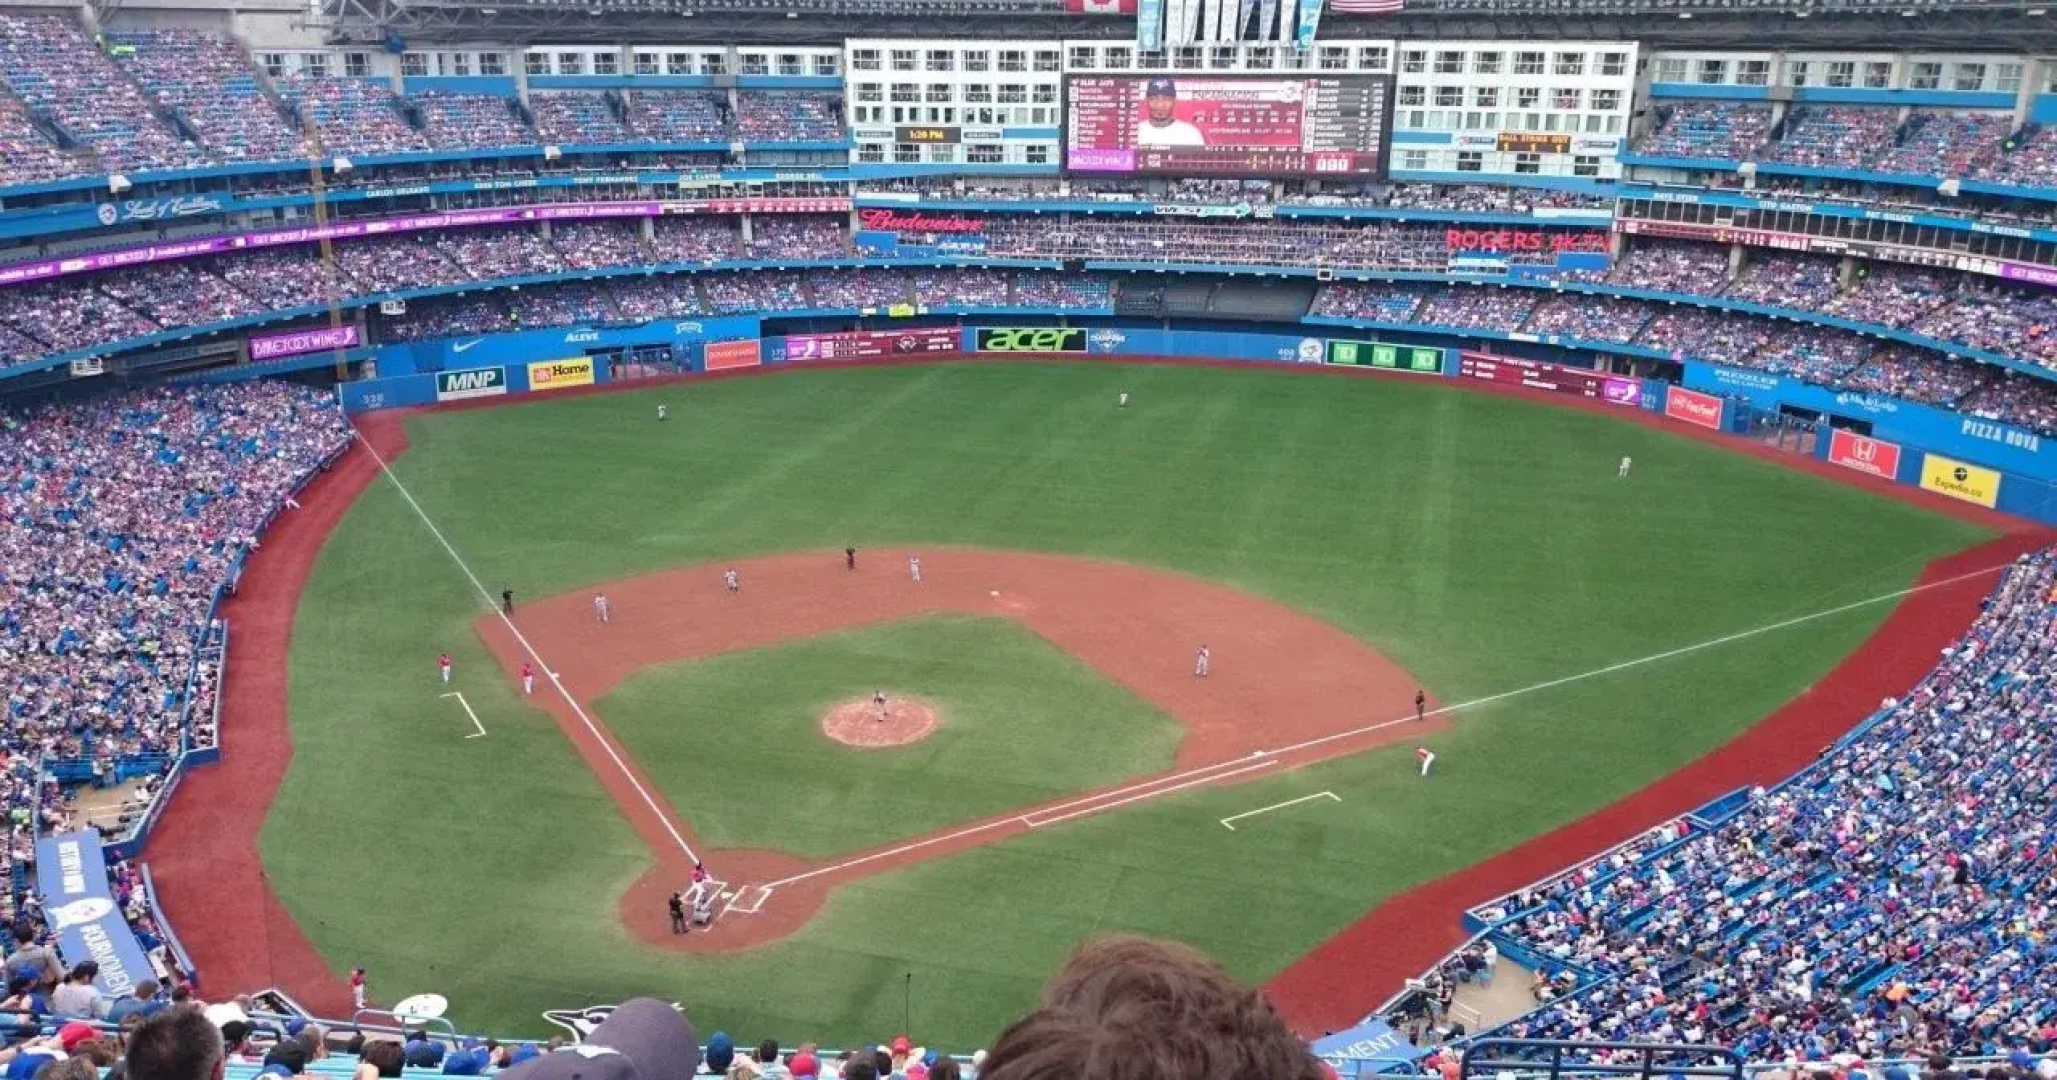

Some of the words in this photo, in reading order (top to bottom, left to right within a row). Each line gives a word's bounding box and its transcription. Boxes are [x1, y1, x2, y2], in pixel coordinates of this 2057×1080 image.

[860, 209, 987, 231] Budweiser
[1447, 230, 1543, 251] ROGERS
[565, 331, 600, 343] ALEVE
[985, 328, 1078, 351] acer
[446, 370, 496, 393] MNP
[552, 364, 590, 377] Home
[1961, 418, 2002, 442] PIZZA
[2005, 429, 2040, 453] NOVA
